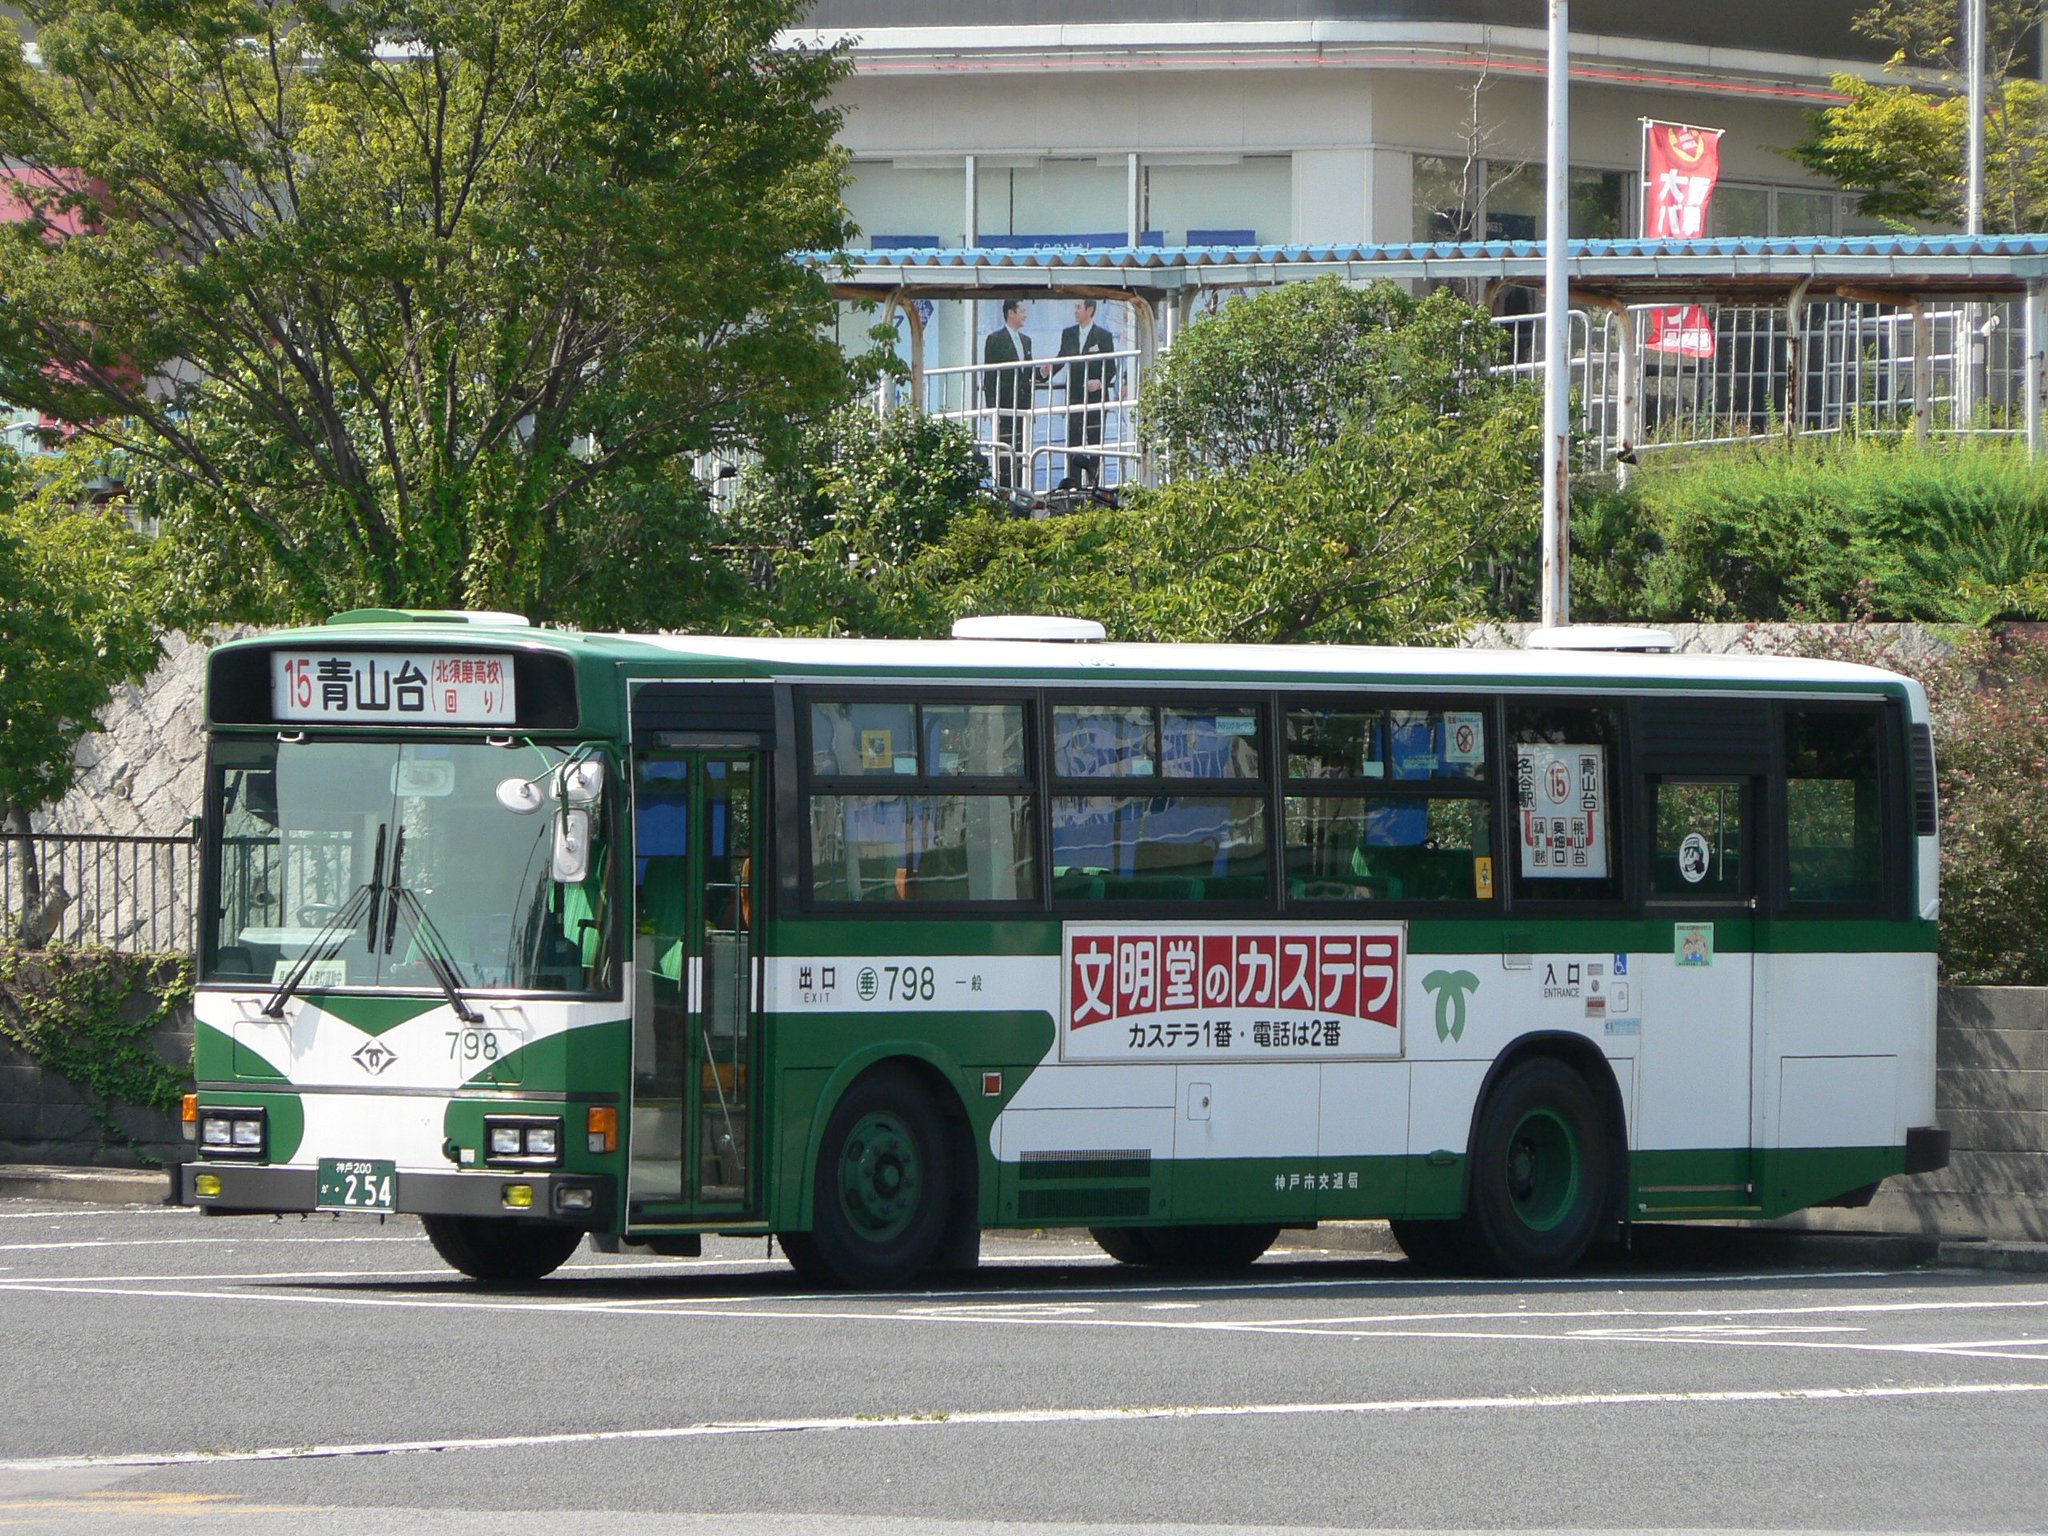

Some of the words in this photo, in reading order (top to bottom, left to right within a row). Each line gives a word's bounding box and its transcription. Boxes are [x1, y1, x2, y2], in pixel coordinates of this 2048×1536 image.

[285, 659, 312, 709] 15
[316, 657, 427, 712] 青山台
[435, 659, 501, 685] 北須磨高校
[1549, 768, 1567, 798] 15
[1580, 758, 1598, 809] 青山台
[799, 966, 836, 990] 出口
[883, 966, 936, 1002] 798
[955, 974, 983, 992] 一般
[1073, 940, 1395, 1023] 文明堂のカステラ
[1543, 962, 1581, 986] 入口
[803, 992, 831, 1004] EXIT
[1543, 987, 1581, 999] ENTRANCE
[445, 1031, 499, 1061] 798
[335, 1161, 372, 1175] 神戸200
[1274, 1171, 1359, 1191] 神戸市交通局
